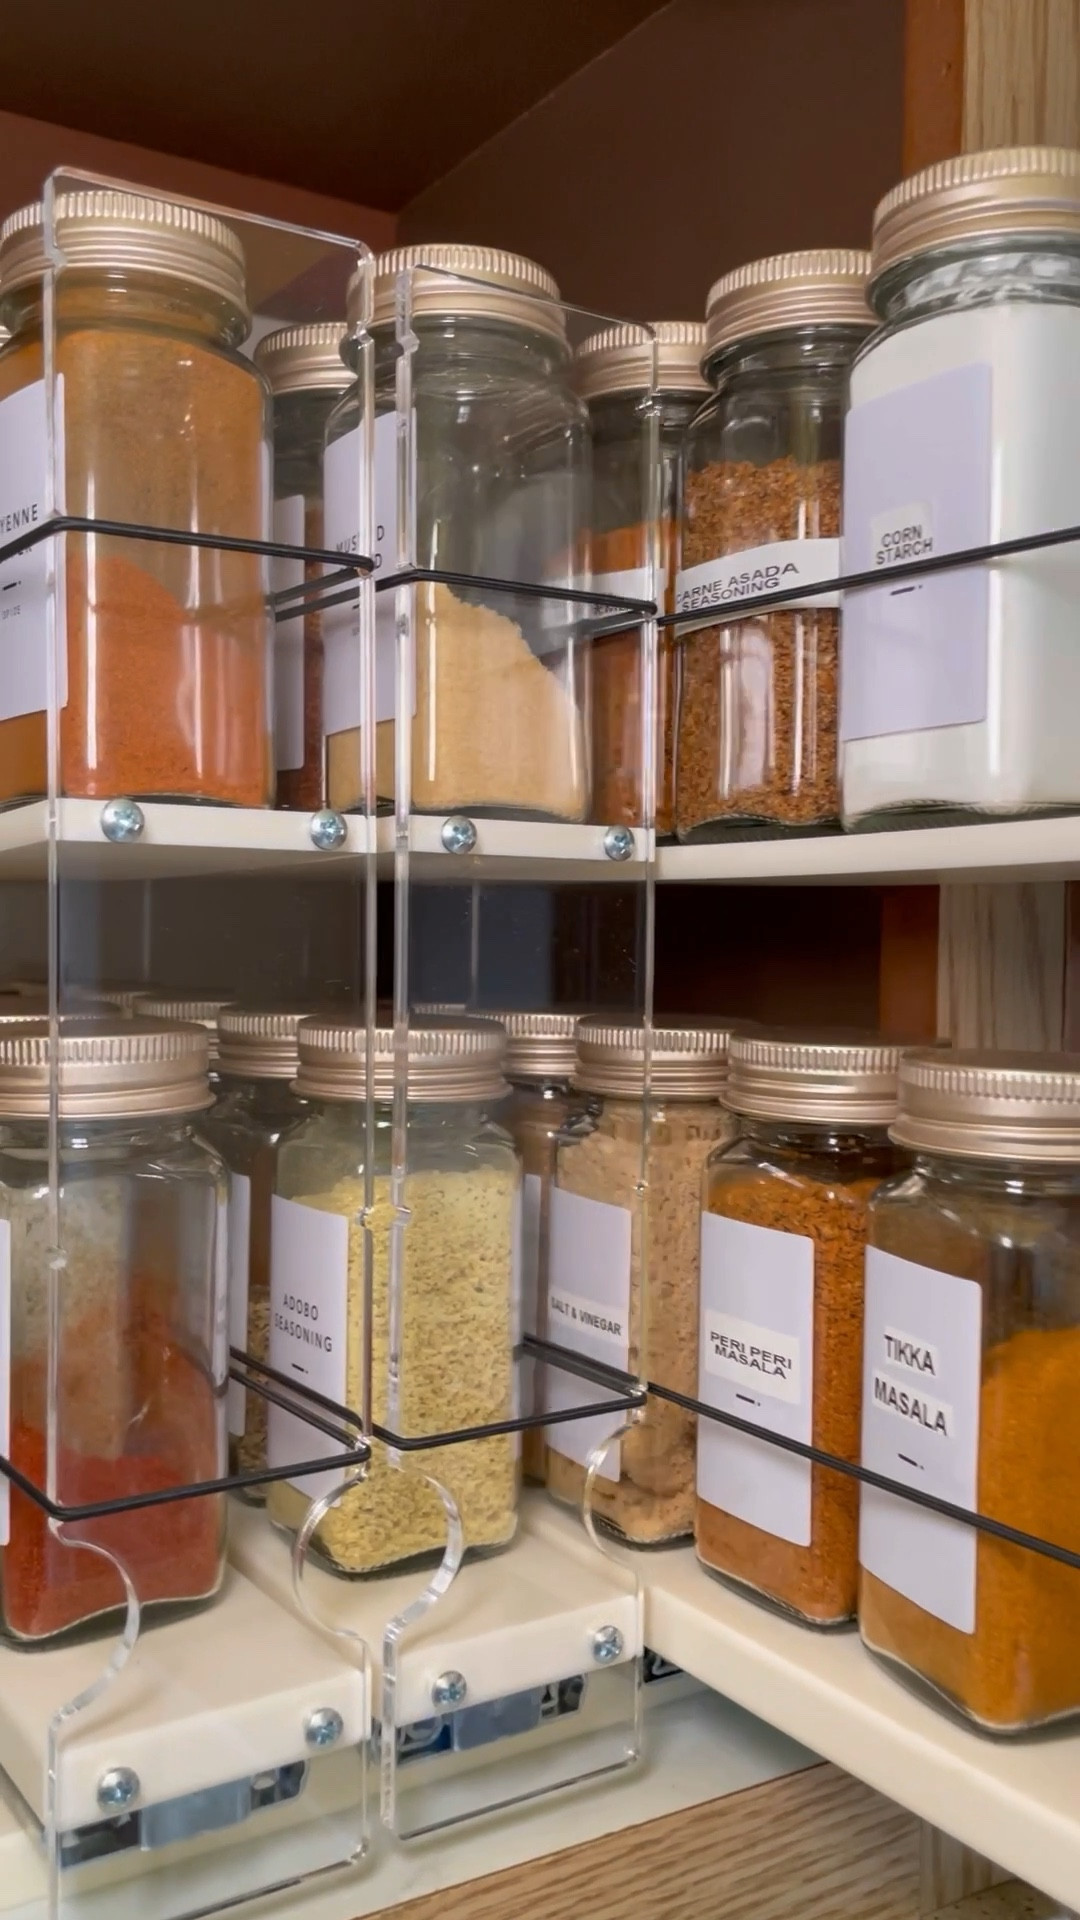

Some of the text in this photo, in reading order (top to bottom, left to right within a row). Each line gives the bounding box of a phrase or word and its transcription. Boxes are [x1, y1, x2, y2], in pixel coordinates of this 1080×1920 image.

[876, 537, 933, 565] STARCH
[881, 524, 922, 548] CORN
[728, 563, 799, 587] ASADA
[682, 577, 779, 612] SEASONING
[283, 1294, 319, 1321] ADOBO
[571, 1306, 577, 1319] &
[579, 1309, 622, 1336] VINEGAR
[275, 1312, 332, 1352] SEASONING
[710, 1331, 792, 1369] PERI PERI
[714, 1344, 787, 1380] MASALA
[884, 1334, 936, 1376] TIKKA
[874, 1377, 948, 1436] MASALA
